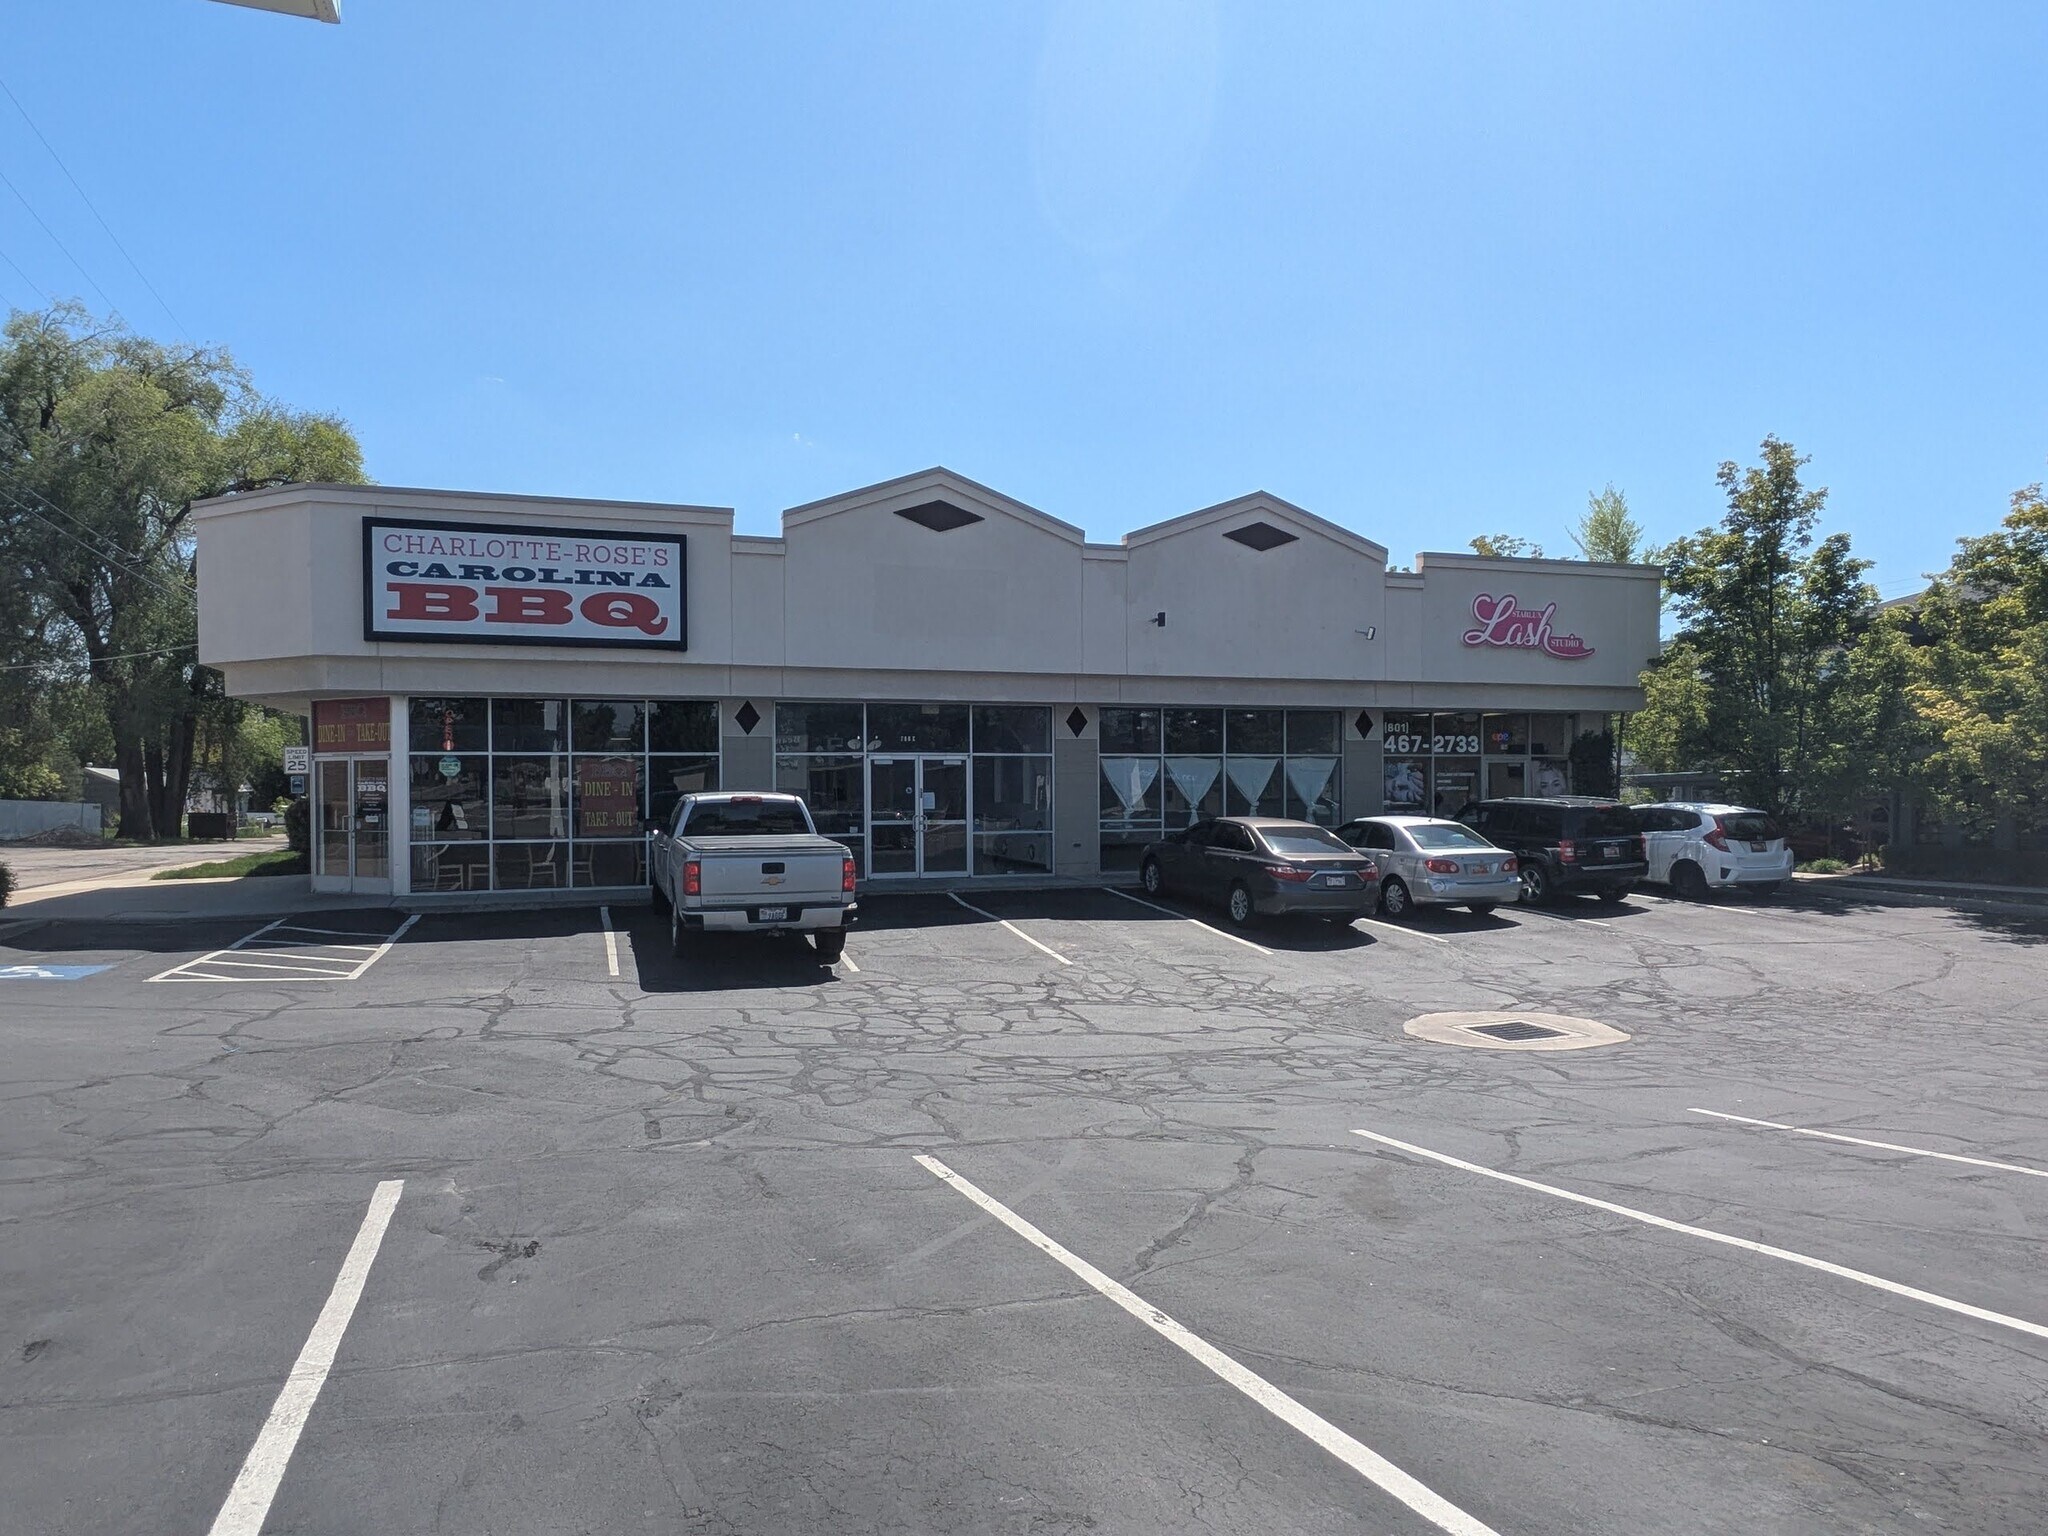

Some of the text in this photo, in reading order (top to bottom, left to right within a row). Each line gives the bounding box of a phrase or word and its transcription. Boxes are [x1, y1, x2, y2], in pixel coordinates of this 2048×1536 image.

[383, 533, 669, 567] CHARLOTTE-ROSE'S
[386, 560, 671, 588] CAROLINA
[386, 582, 669, 636] BBQ
[1465, 594, 1594, 657] Lash
[1550, 637, 1580, 648] STUDIO
[317, 724, 346, 743] DINE-IN
[1384, 735, 1479, 753] 467-2733
[287, 760, 307, 771] 25
[357, 784, 387, 792] BBQ
[585, 781, 611, 796] DINE
[621, 781, 633, 796] IN
[585, 811, 608, 827] TAKE
[616, 811, 632, 827] OUT
